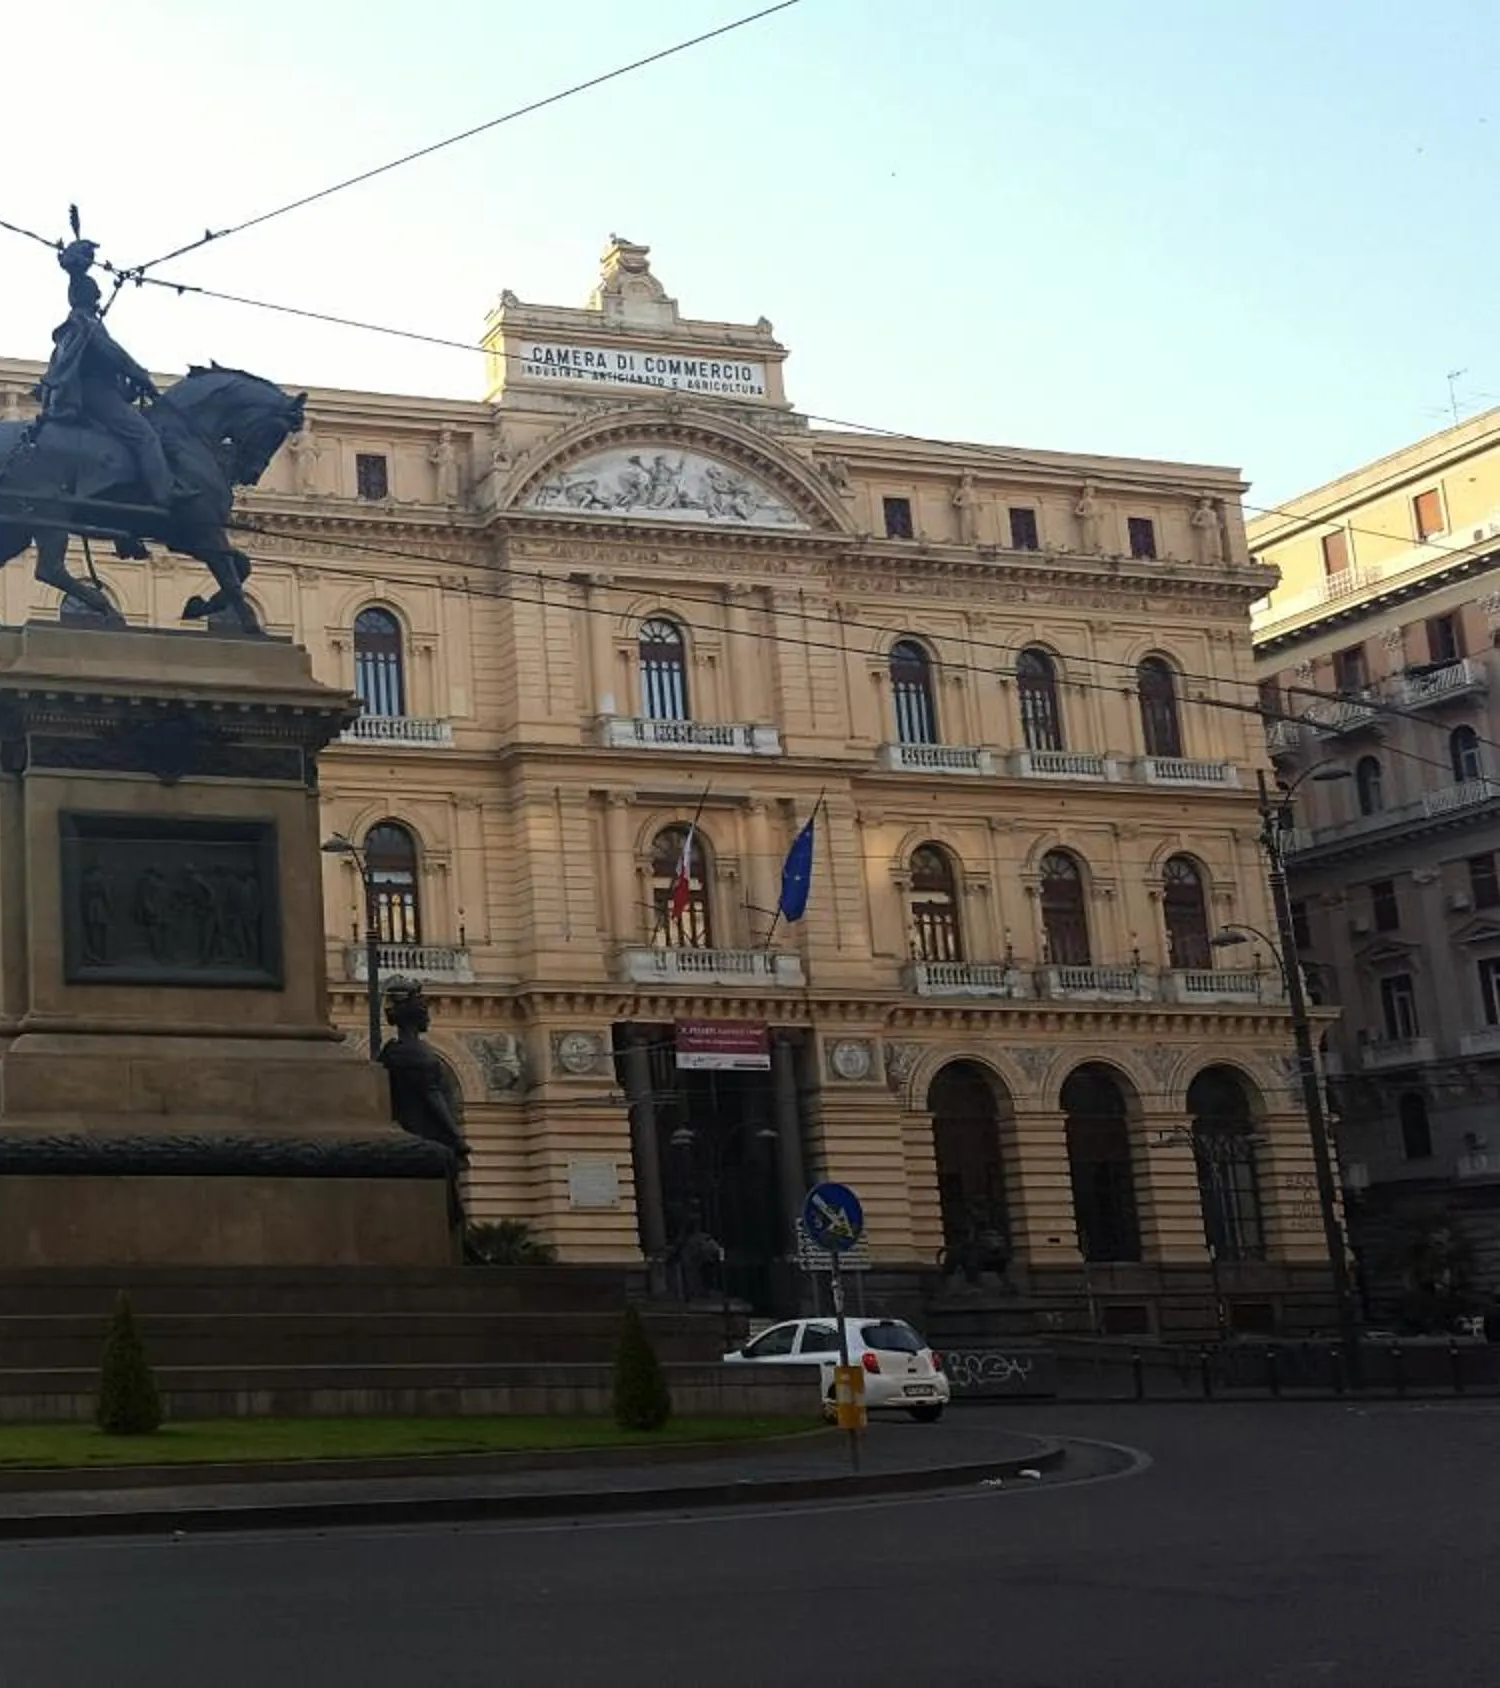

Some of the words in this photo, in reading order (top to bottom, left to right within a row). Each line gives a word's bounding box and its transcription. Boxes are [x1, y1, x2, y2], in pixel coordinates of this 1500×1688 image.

[533, 347, 607, 369] CAMERA
[617, 354, 635, 371] DI
[645, 357, 752, 381] COMMERCIO
[592, 371, 665, 388] ARTIGIANATO
[672, 377, 679, 389] E
[687, 379, 763, 395] AGRICOLTURA
